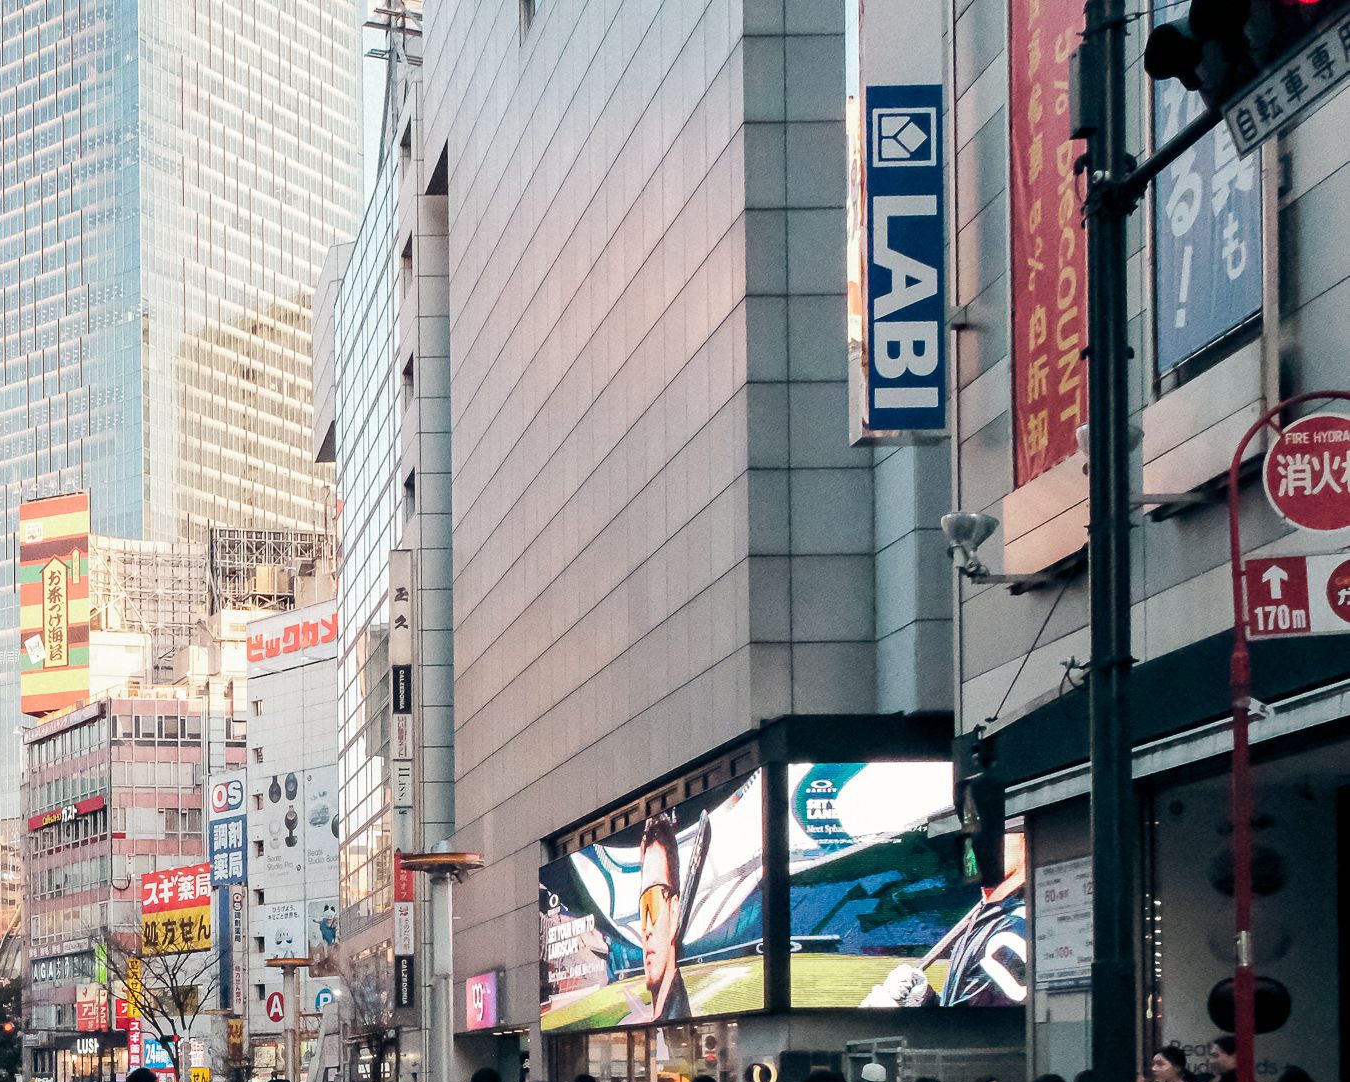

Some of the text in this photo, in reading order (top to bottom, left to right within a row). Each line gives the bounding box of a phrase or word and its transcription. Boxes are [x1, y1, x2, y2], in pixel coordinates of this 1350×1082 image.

[873, 195, 939, 410] LABI
[1285, 432, 1310, 445] FIRE
[47, 570, 64, 662] お茶づけ海苔
[1254, 603, 1307, 632] 170m
[212, 780, 243, 809] OS
[213, 820, 243, 852] 調剤
[213, 851, 243, 881] 薬局
[143, 872, 210, 906] スギ薬局
[143, 914, 210, 947] 処方せん
[33, 960, 54, 981] AGA
[269, 994, 284, 1017] A
[130, 1021, 140, 1064] スギ薬局
